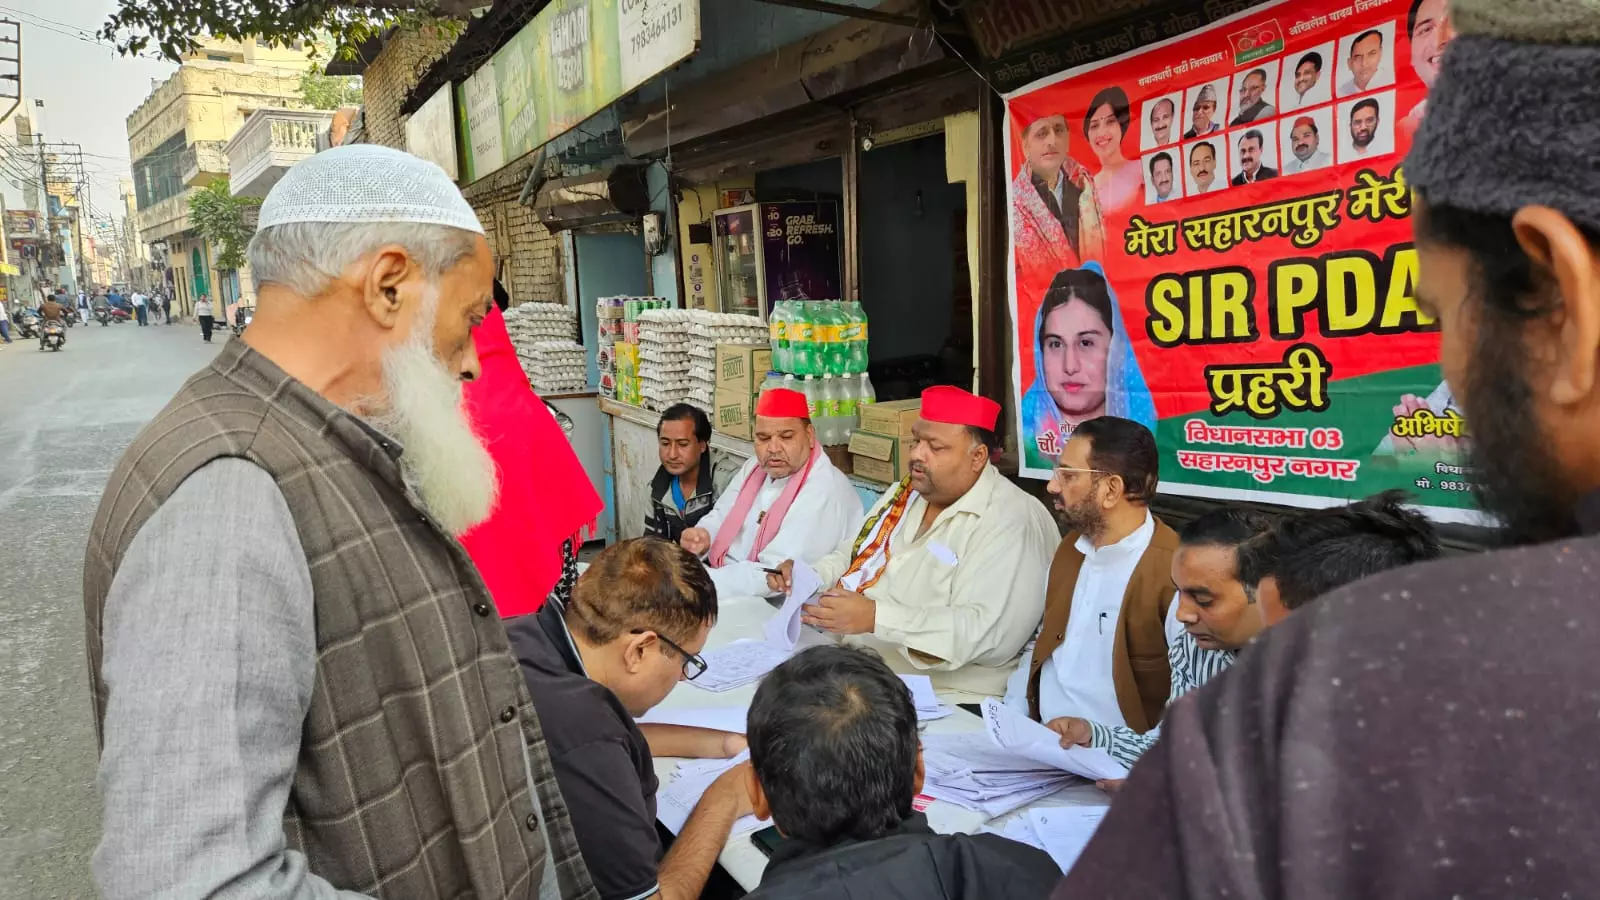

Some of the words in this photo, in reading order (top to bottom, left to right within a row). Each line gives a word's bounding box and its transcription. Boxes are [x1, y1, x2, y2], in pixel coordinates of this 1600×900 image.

[631, 3, 682, 55] 7983464131
[1289, 15, 1327, 36] अखिलेश
[1329, 6, 1353, 21] यादव
[994, 62, 1031, 82] कोल्ड
[1066, 40, 1094, 64] और
[1138, 19, 1157, 41] के
[1161, 12, 1200, 35] थोक
[785, 214, 816, 225] GRAB.
[785, 223, 834, 236] REFRESH.
[1126, 218, 1176, 256] मेरा
[1183, 193, 1340, 245] सहारनपुर
[786, 235, 805, 246] GO.
[1150, 271, 1251, 344] SIR
[1275, 248, 1435, 335] PDA
[1208, 347, 1326, 415] प्रहरी
[1186, 420, 1307, 448] विधानसभा
[1311, 428, 1342, 449] 03
[1393, 408, 1466, 438] अभिषे
[1037, 430, 1062, 454] चौ.
[1178, 451, 1286, 482] सहारनपुर
[1288, 457, 1359, 480] नगर
[1415, 477, 1434, 489] मो.
[1440, 481, 1472, 492] 9837
